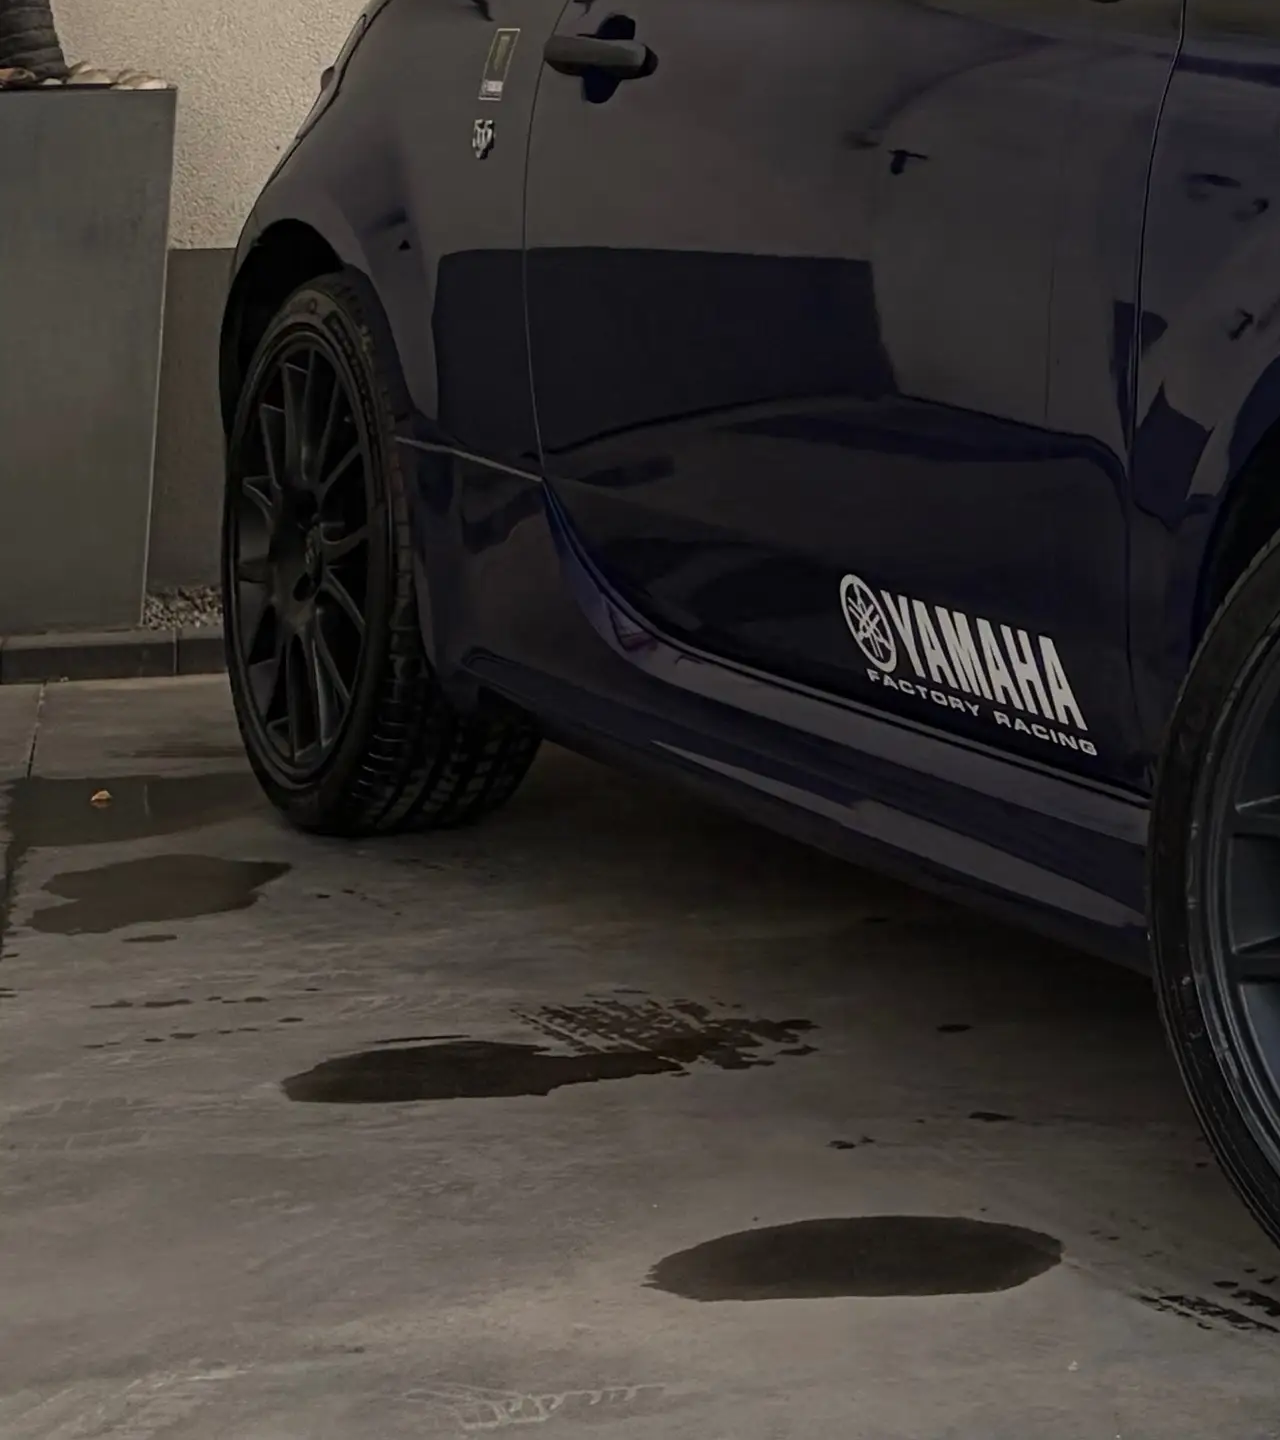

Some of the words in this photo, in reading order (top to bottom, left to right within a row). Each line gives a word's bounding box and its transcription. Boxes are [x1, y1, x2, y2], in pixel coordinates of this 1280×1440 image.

[866, 668, 980, 718] FACTORY
[993, 710, 1098, 757] RACING
[880, 589, 1089, 731] YAMAHA
